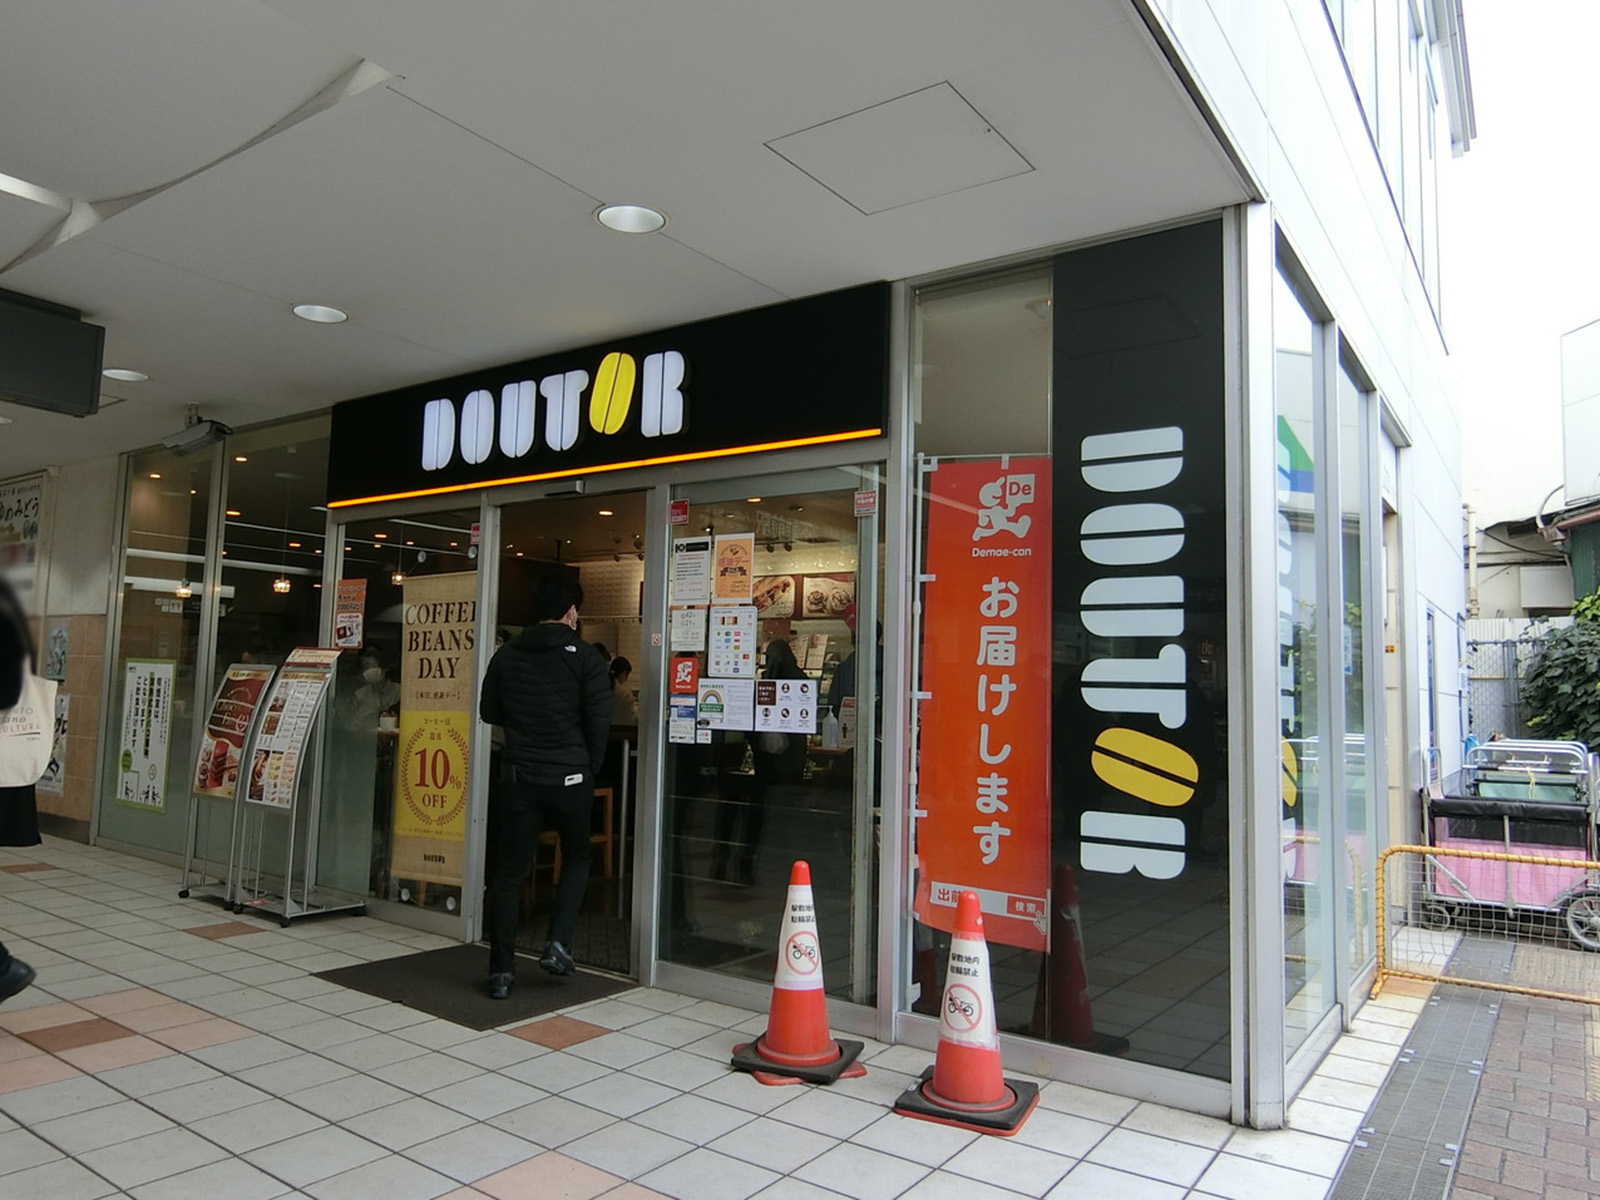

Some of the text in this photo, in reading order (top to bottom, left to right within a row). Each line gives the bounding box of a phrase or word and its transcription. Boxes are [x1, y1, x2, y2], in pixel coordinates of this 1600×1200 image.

[421, 350, 686, 472] DOUTOR
[1009, 481, 1032, 496] De
[972, 547, 1032, 558] Demae-can
[408, 628, 474, 652] BEANS
[1080, 425, 1199, 880] DOUTOR
[418, 657, 460, 679] DAY
[972, 576, 1019, 865] お届けします
[414, 748, 462, 790] 10%
[422, 793, 447, 808] OFF
